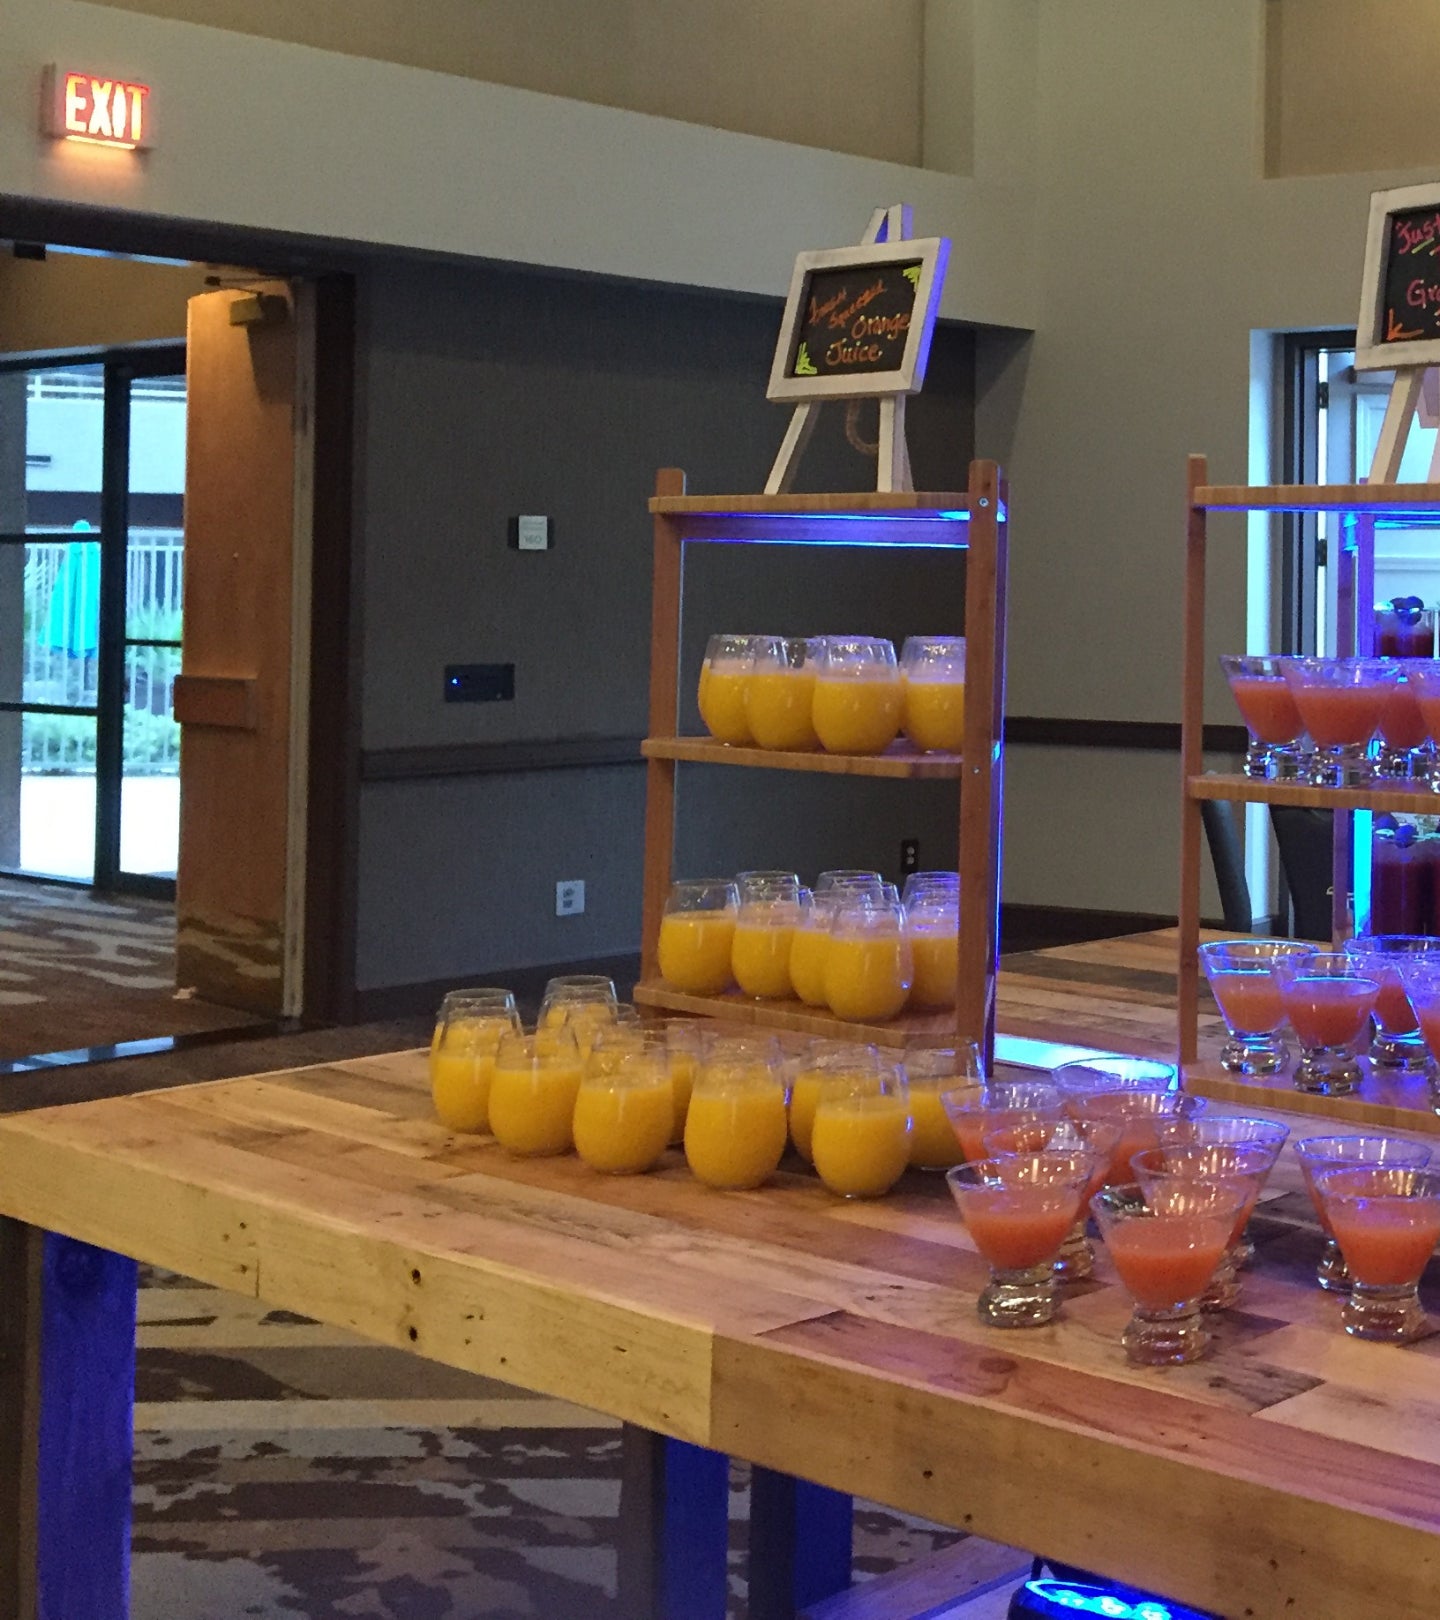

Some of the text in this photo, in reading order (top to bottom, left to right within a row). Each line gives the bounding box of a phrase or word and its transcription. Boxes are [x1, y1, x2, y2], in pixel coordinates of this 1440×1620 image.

[65, 73, 149, 141] EXIT
[851, 313, 911, 340] Orange
[826, 337, 883, 366] Juice
